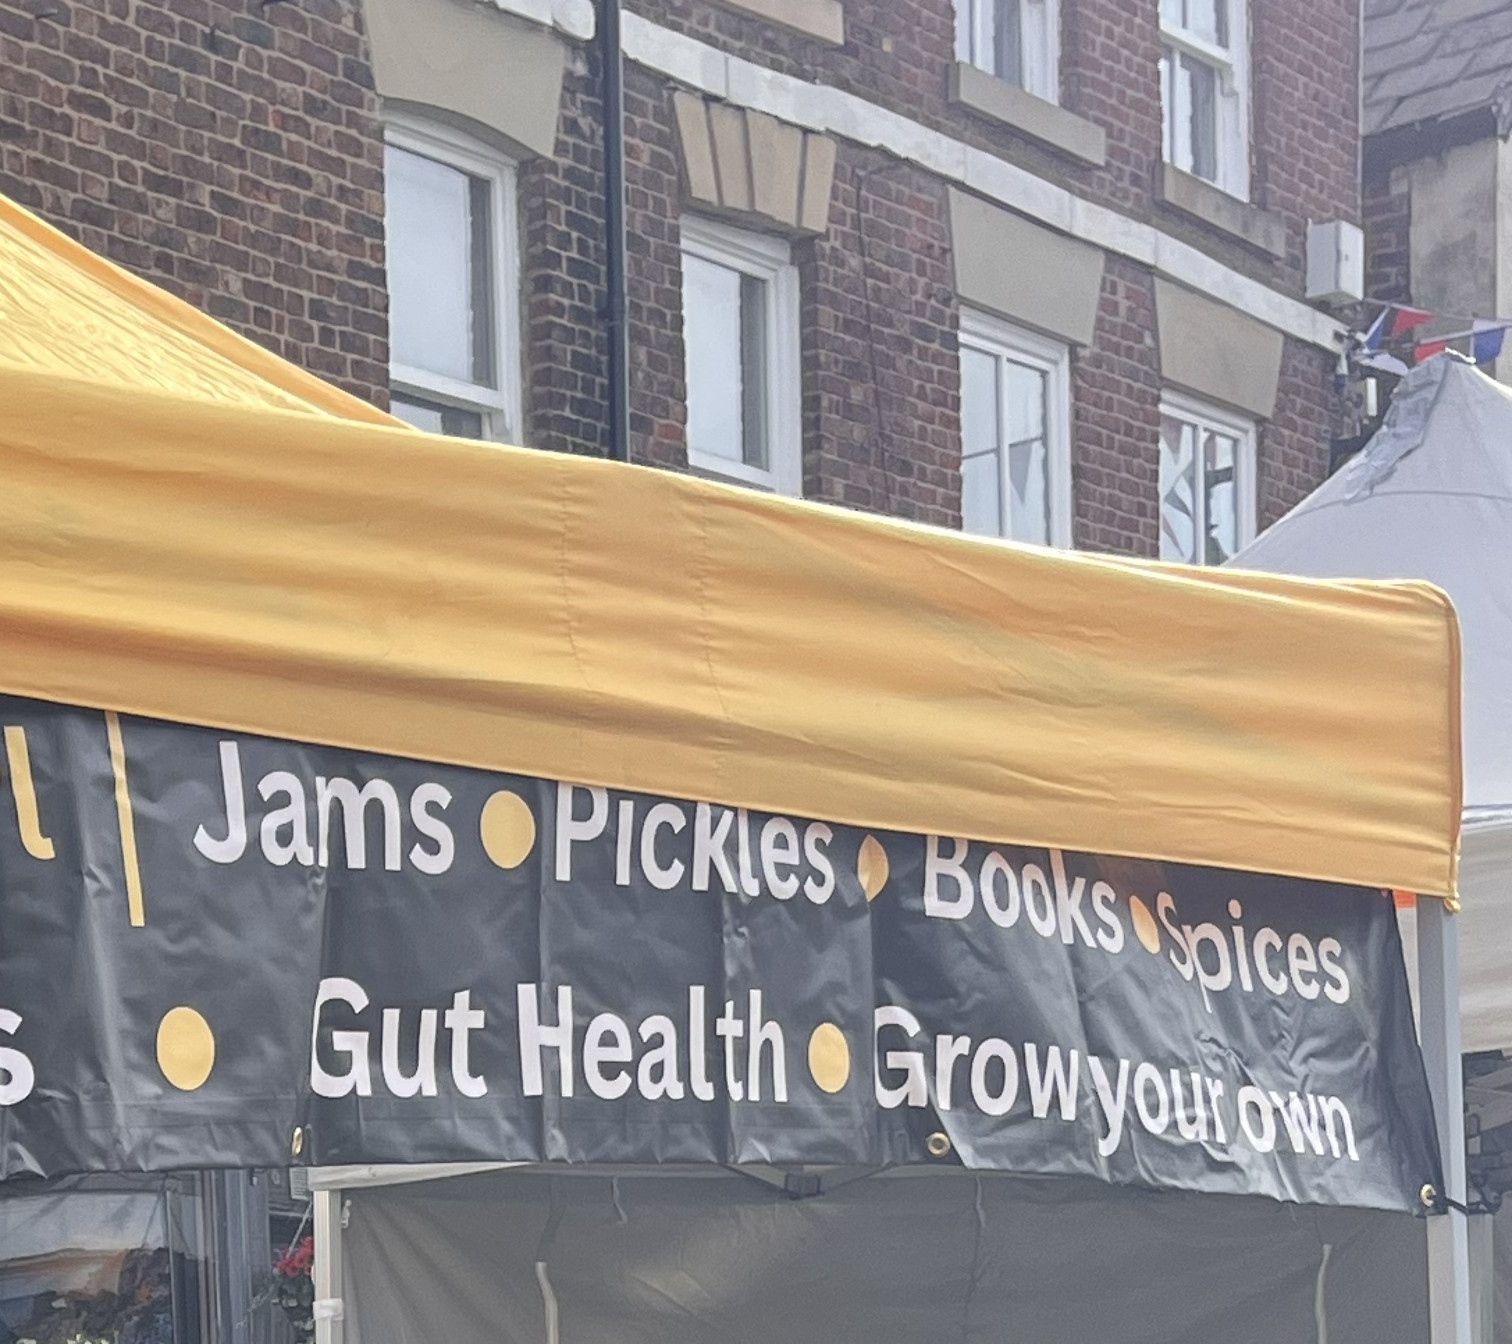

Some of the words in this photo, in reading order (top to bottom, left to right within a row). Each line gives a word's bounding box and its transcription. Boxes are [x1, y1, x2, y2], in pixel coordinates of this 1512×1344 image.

[193, 740, 454, 875] Jams
[555, 780, 836, 904] Pickles
[923, 834, 1125, 954] Books
[1157, 891, 1351, 1014] Spices
[310, 976, 488, 1098] Gut
[517, 982, 788, 1102] Health
[874, 1005, 1079, 1122] Grow
[1088, 1055, 1227, 1157] your
[1238, 1085, 1360, 1161] own
